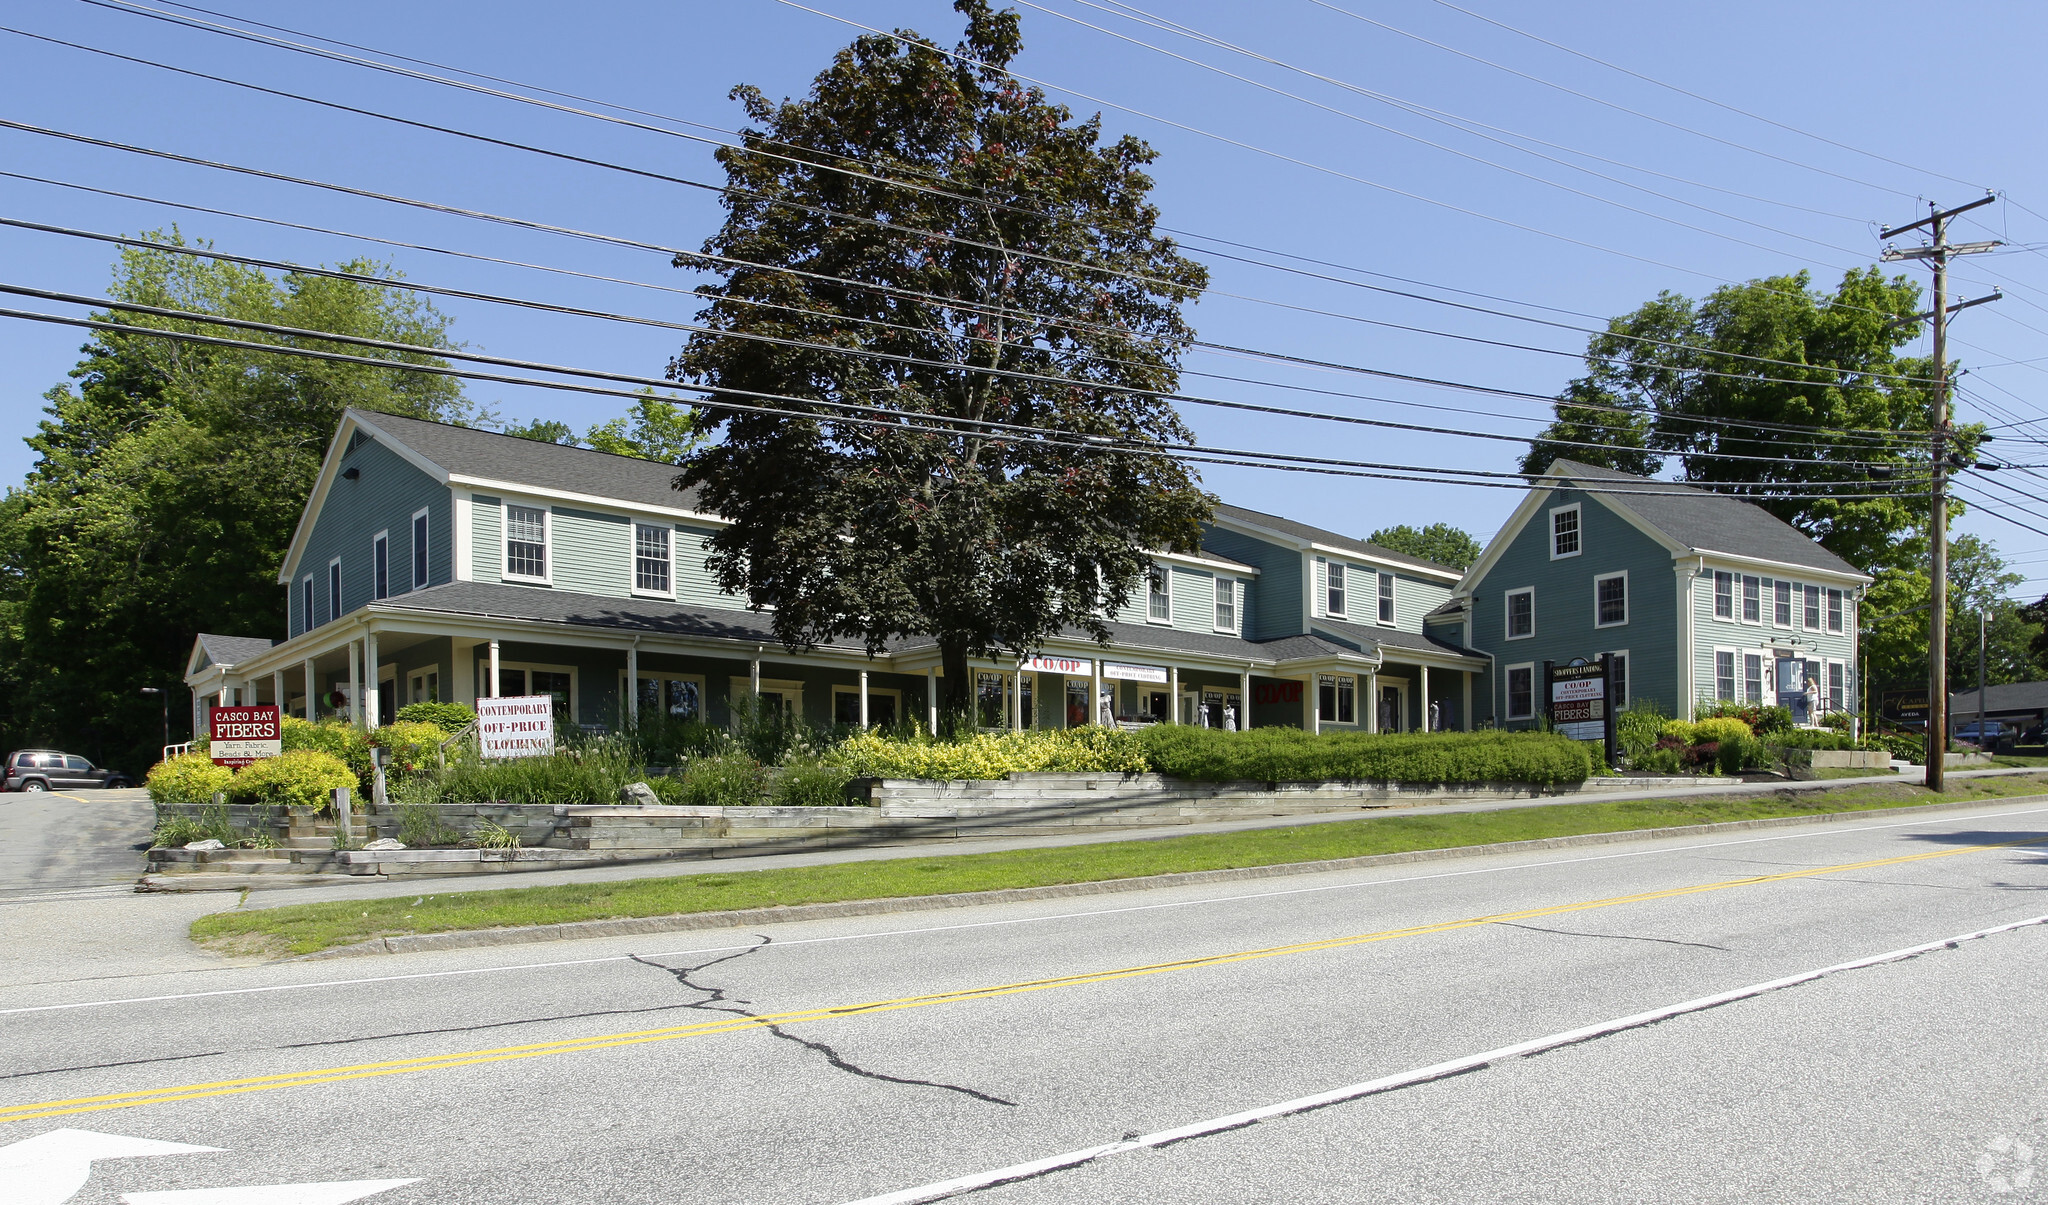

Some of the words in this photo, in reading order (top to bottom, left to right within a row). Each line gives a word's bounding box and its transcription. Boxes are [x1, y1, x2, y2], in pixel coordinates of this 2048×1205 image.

[1033, 657, 1080, 672] CO/OP
[978, 673, 1001, 681] CO/OP
[1066, 681, 1088, 689] CO/OP
[1565, 681, 1592, 689] CO/OP
[1256, 682, 1303, 705] CO/OP
[480, 704, 548, 716] CONTEMPORARY
[1555, 709, 1589, 720] FIBERS
[216, 713, 249, 721] CASCO
[253, 712, 273, 720] BAY
[216, 723, 274, 737] FIBERS
[484, 721, 547, 733] OFF-PRICE
